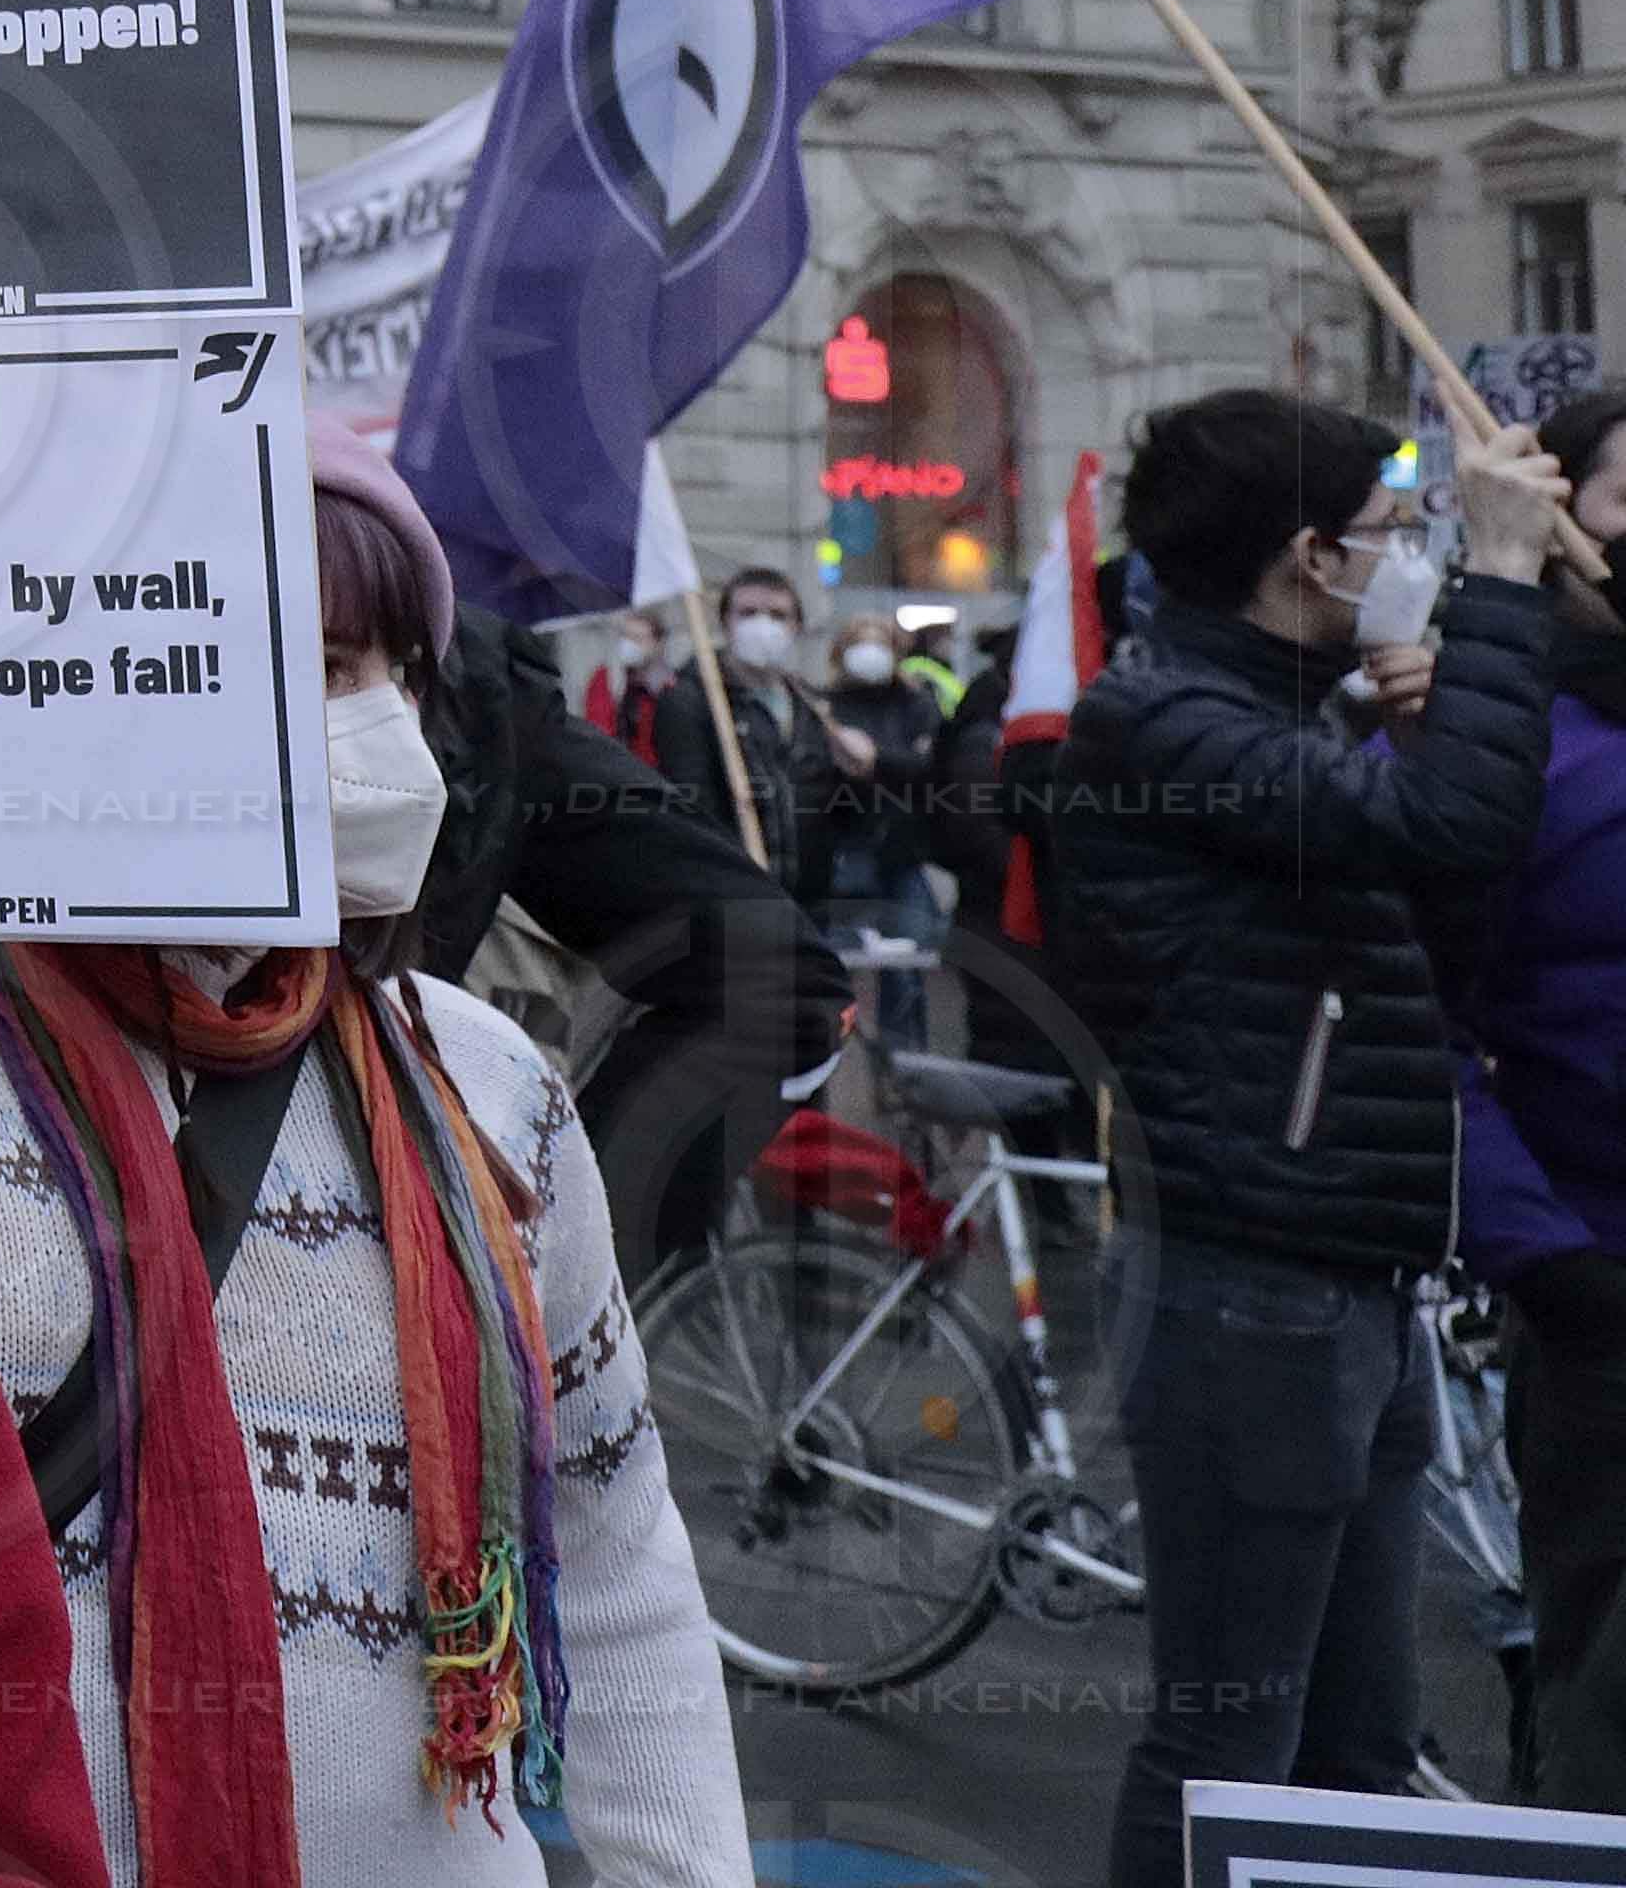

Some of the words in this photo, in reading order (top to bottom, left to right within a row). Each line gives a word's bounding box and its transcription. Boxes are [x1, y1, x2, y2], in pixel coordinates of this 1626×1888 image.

[11, 564, 75, 625] by
[93, 561, 224, 616] wall,
[110, 645, 221, 694] fall!
